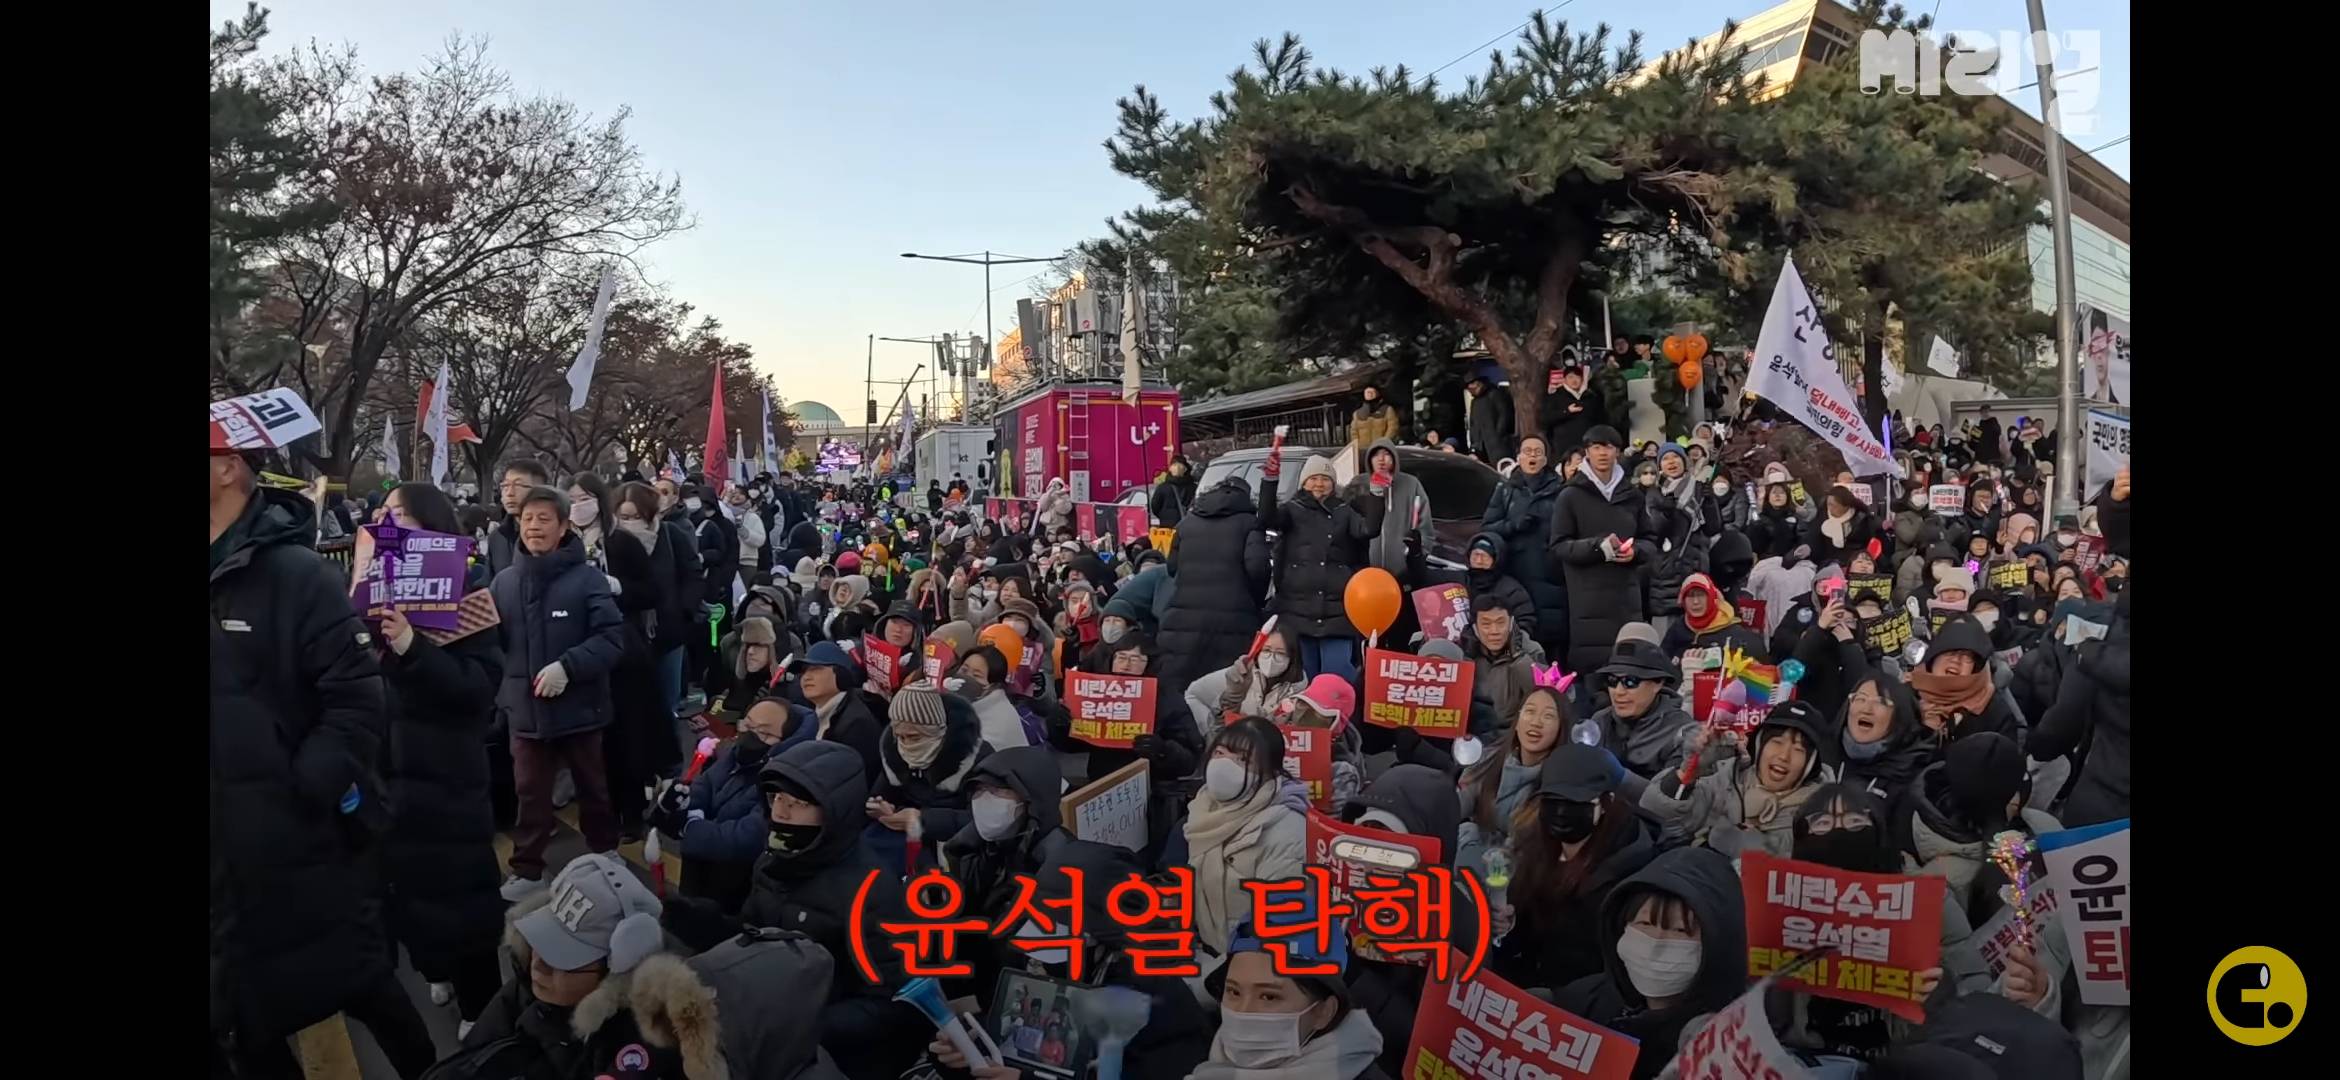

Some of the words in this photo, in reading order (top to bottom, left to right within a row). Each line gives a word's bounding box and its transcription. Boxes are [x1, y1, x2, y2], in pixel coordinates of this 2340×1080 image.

[406, 537, 459, 552] 이름으로
[1379, 658, 1459, 683] 내란수괴
[1074, 679, 1143, 698] 내란수괴
[1387, 682, 1446, 707] 윤석열
[1080, 700, 1132, 720] 윤석열
[1370, 702, 1410, 727] 탄핵!
[1413, 706, 1461, 728] 체포!
[1071, 719, 1102, 739] 탄핵!
[1104, 721, 1147, 740] 체포!
[1767, 870, 1915, 920] 내란수괴
[1782, 916, 1891, 962] 윤석열
[1447, 970, 1603, 1074] 내란수괴
